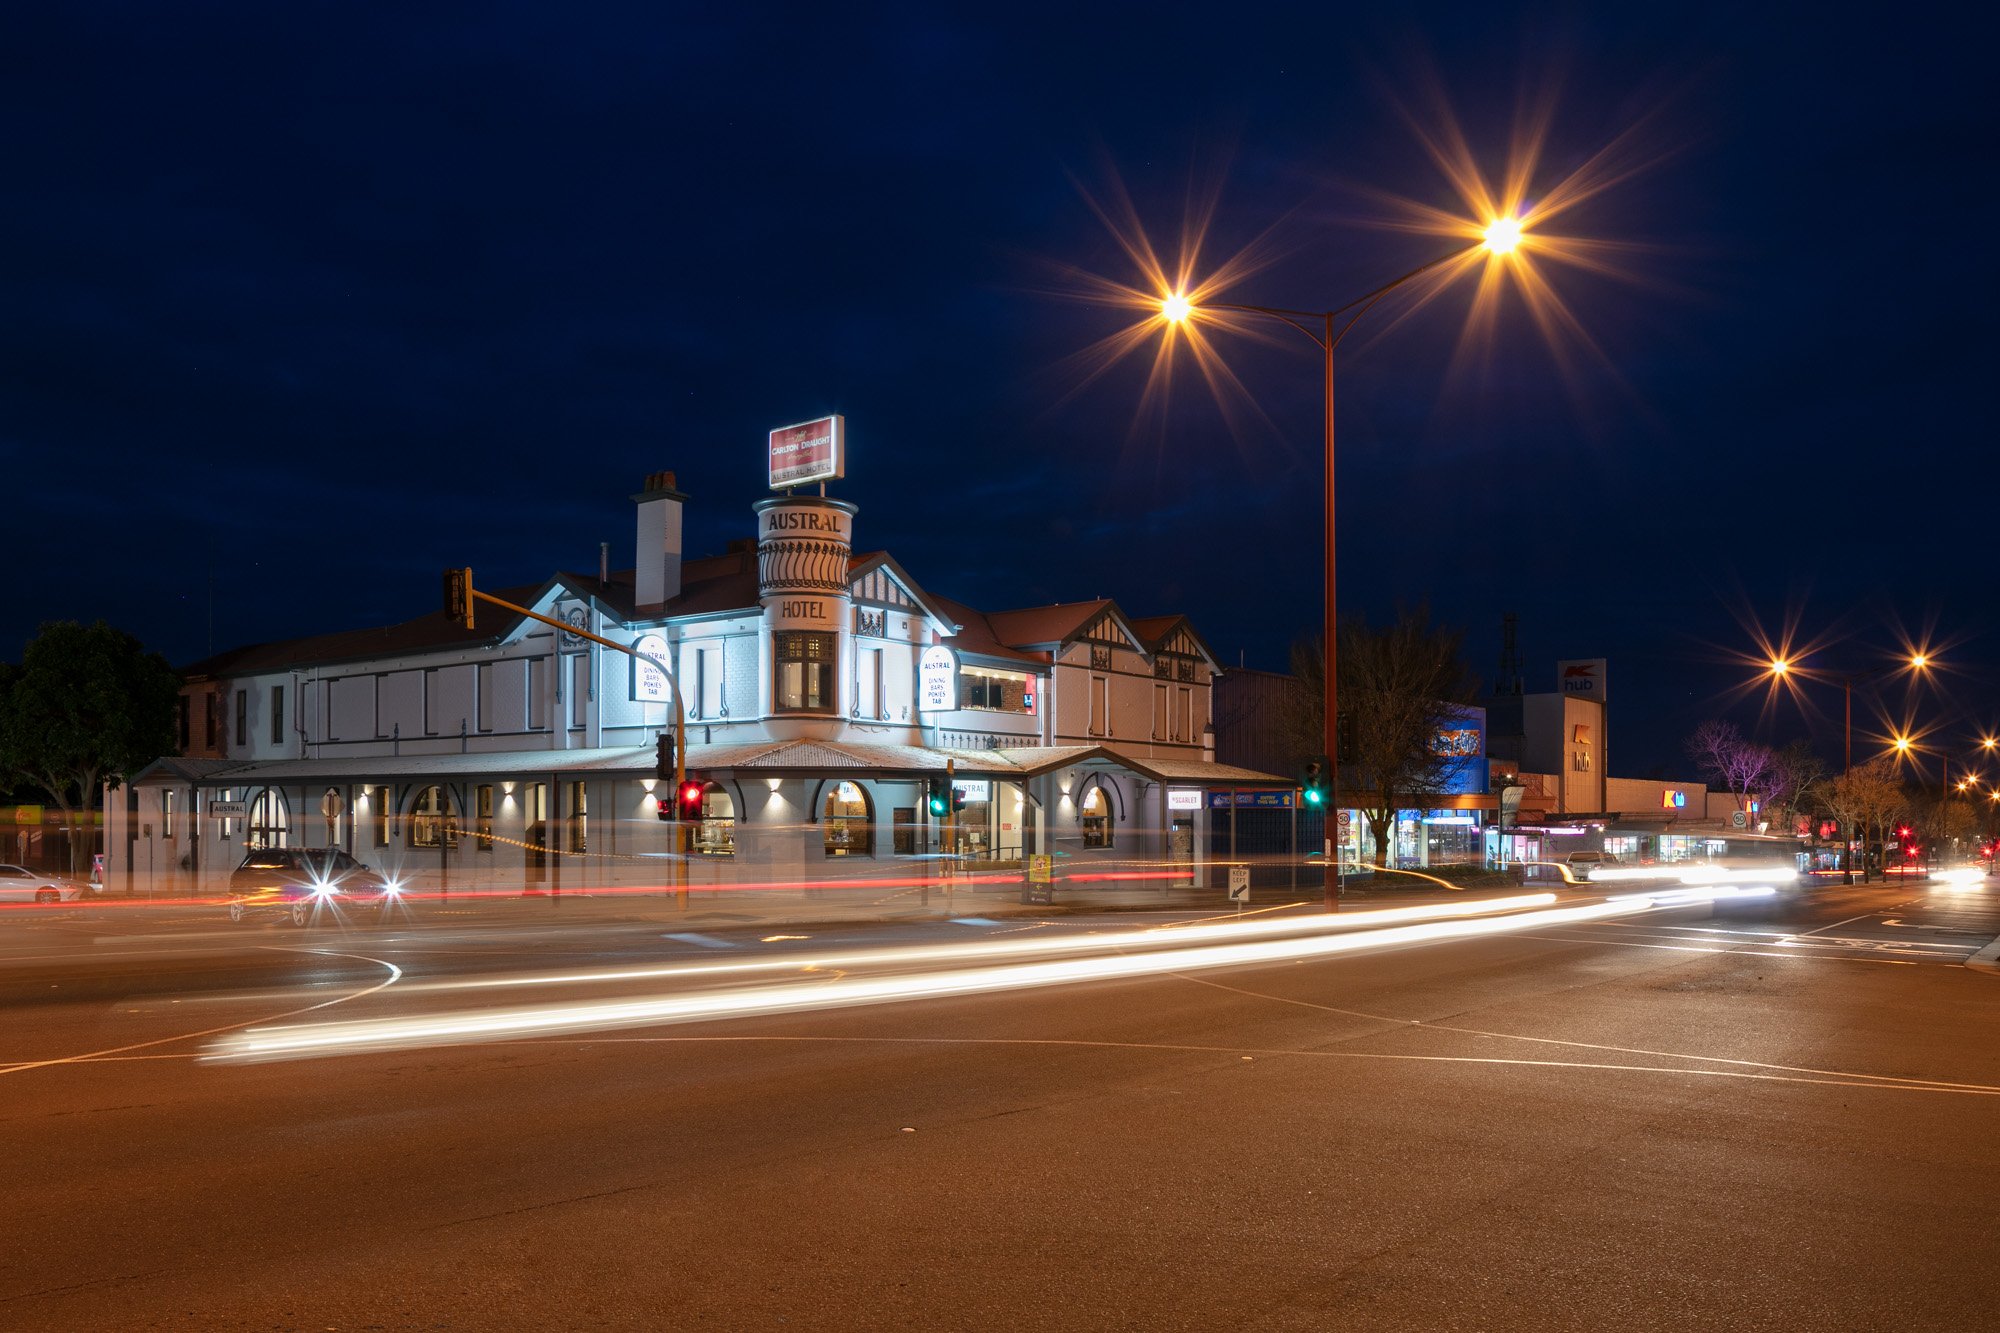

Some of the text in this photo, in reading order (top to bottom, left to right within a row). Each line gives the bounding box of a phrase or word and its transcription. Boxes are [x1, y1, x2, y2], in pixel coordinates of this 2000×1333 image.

[771, 443, 799, 455] CARLTON
[801, 436, 831, 450] DRAUGHT
[772, 463, 831, 481] AUSTRAL HOTEL
[769, 512, 841, 533] AUSTRAL
[782, 601, 827, 619] HOTEL
[641, 651, 666, 661] USTRAL
[924, 662, 950, 670] AUSTRAL
[646, 674, 660, 682] BARS
[643, 681, 662, 689] POKIES
[1565, 679, 1592, 691] hub
[1573, 751, 1591, 771] hub
[1339, 815, 1349, 823] 50
